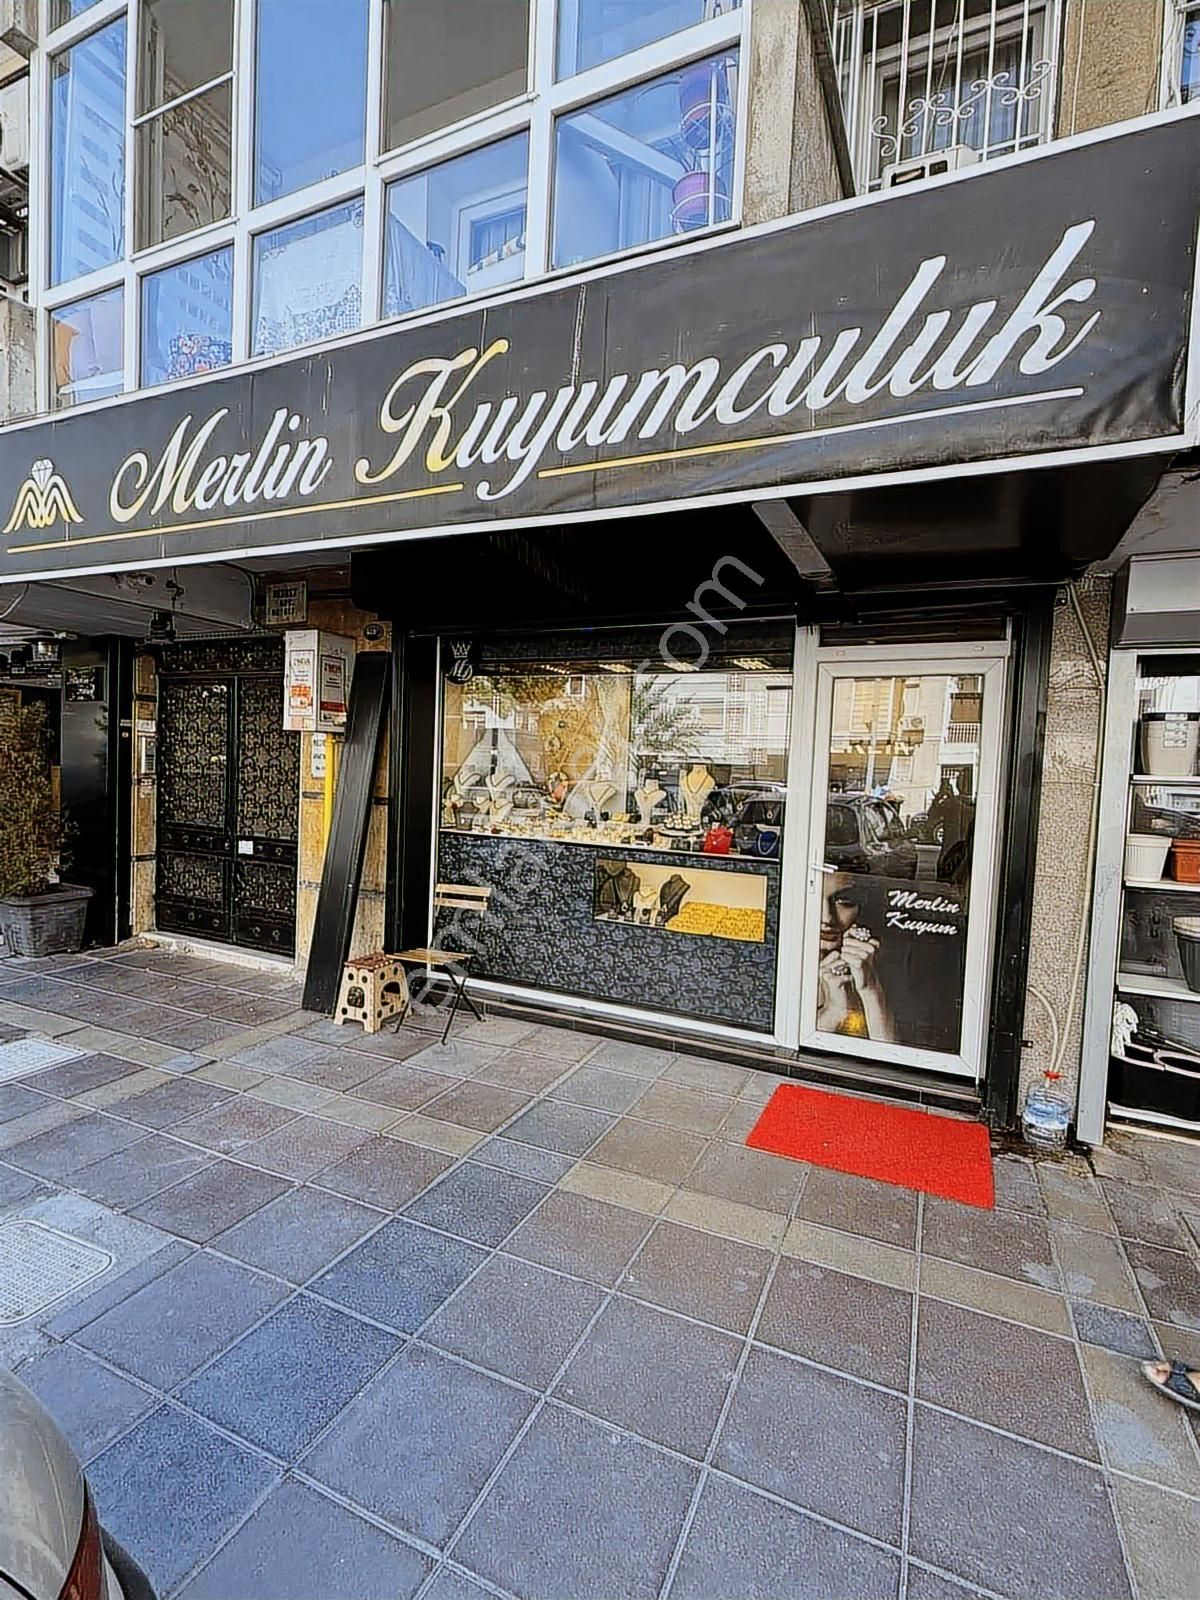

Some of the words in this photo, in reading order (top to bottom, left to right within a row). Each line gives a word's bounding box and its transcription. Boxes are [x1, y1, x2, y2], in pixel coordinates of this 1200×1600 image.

[109, 408, 333, 523] Merlin
[355, 219, 1102, 501] Kuyumculuk
[888, 889, 960, 913] Merlin
[885, 911, 958, 935] Kuyum
